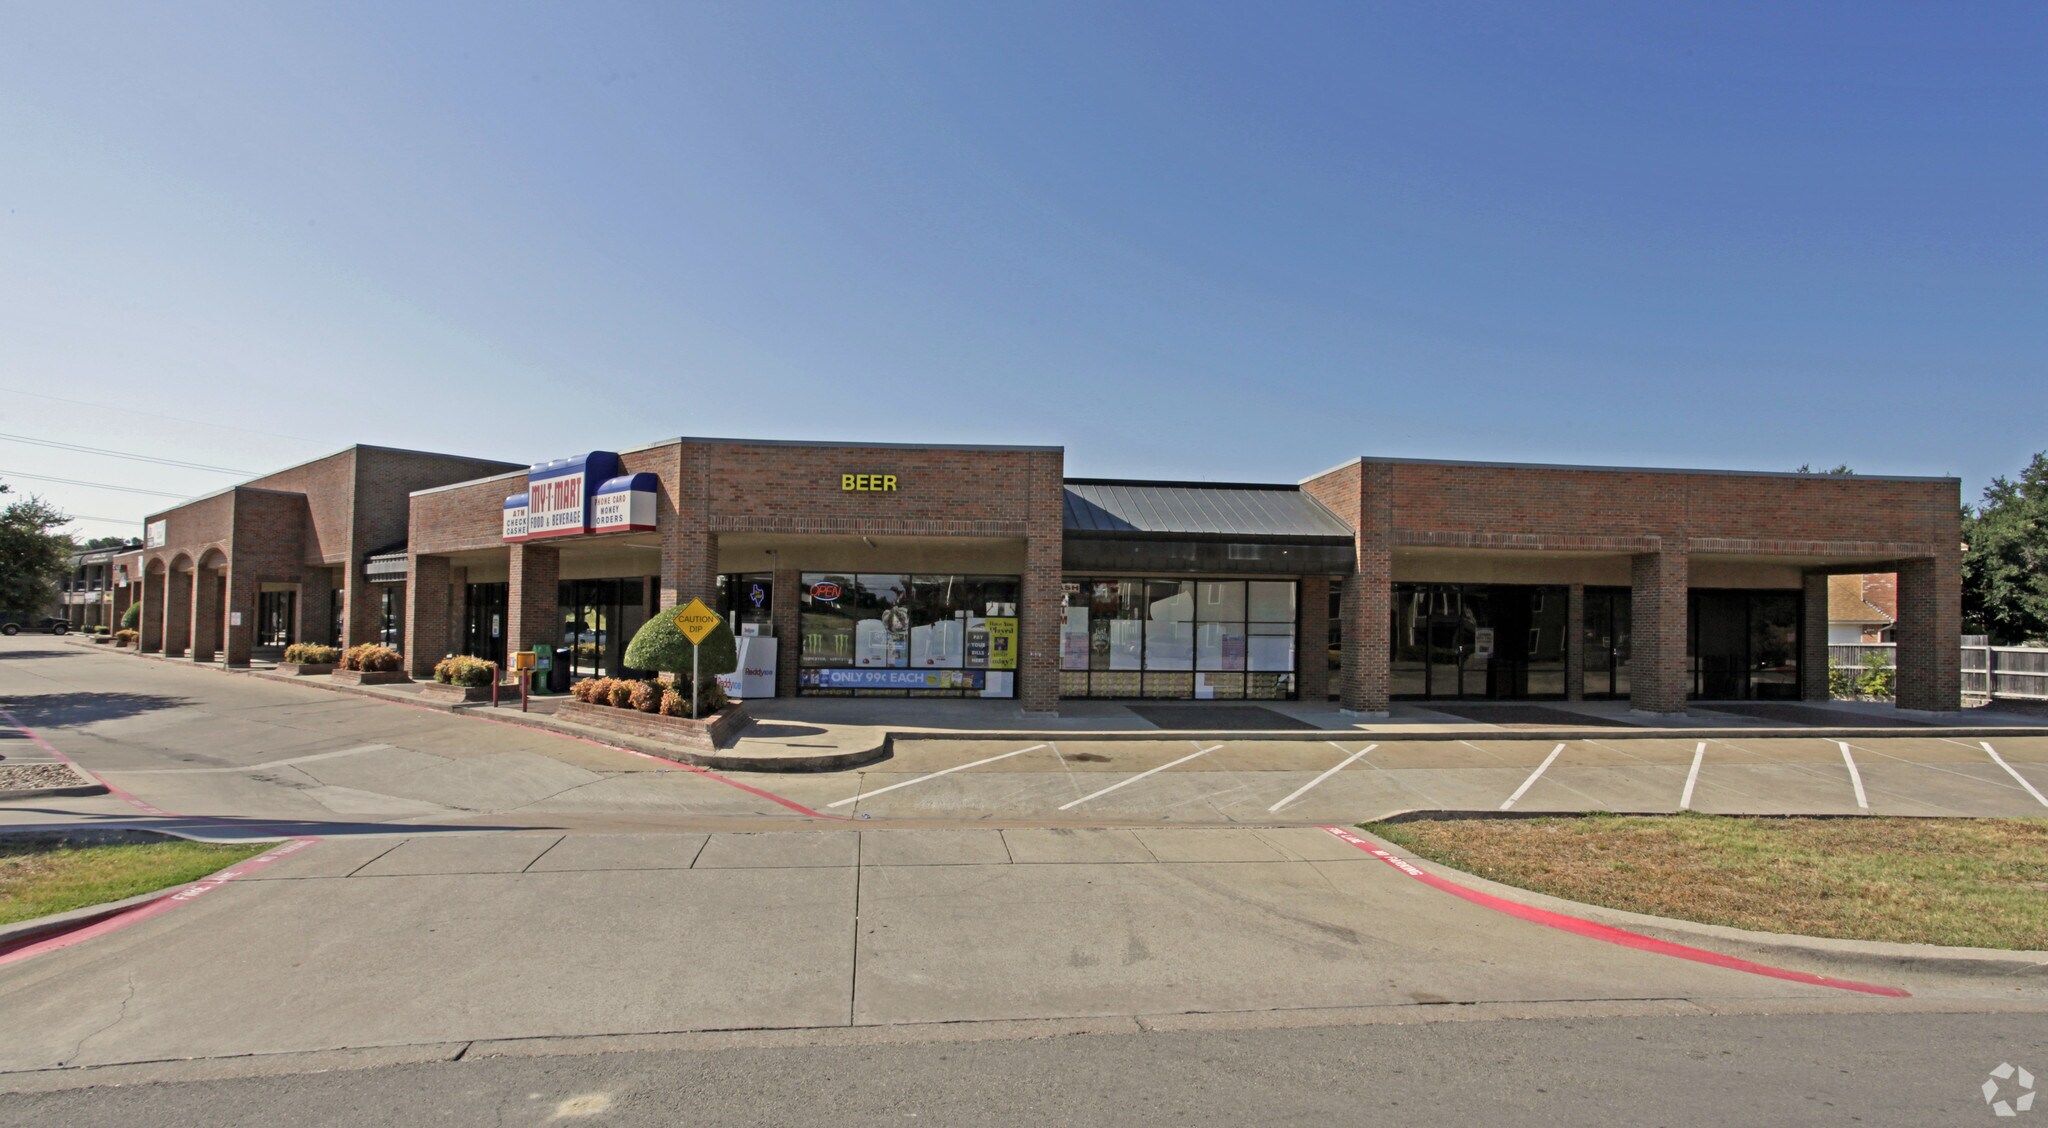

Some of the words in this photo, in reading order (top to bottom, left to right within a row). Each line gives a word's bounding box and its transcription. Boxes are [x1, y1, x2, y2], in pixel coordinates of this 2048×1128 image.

[841, 473, 897, 491] BEER
[594, 496, 611, 506] PHONE
[612, 494, 626, 504] CARD
[513, 508, 525, 517] ATM
[600, 505, 619, 515] MONEY
[506, 516, 529, 527] CHECK
[530, 515, 544, 529] FOOD
[552, 510, 581, 526] BEVERAGE
[596, 514, 624, 525] ORDERS
[506, 526, 529, 535] CASHE
[810, 585, 841, 597] OPEN
[678, 615, 714, 624] CAUTION
[689, 625, 703, 633] DIP
[831, 672, 864, 682] ONLY
[866, 672, 887, 682] 99¢
[890, 672, 924, 683] EACH
[170, 886, 212, 900] FIRE
